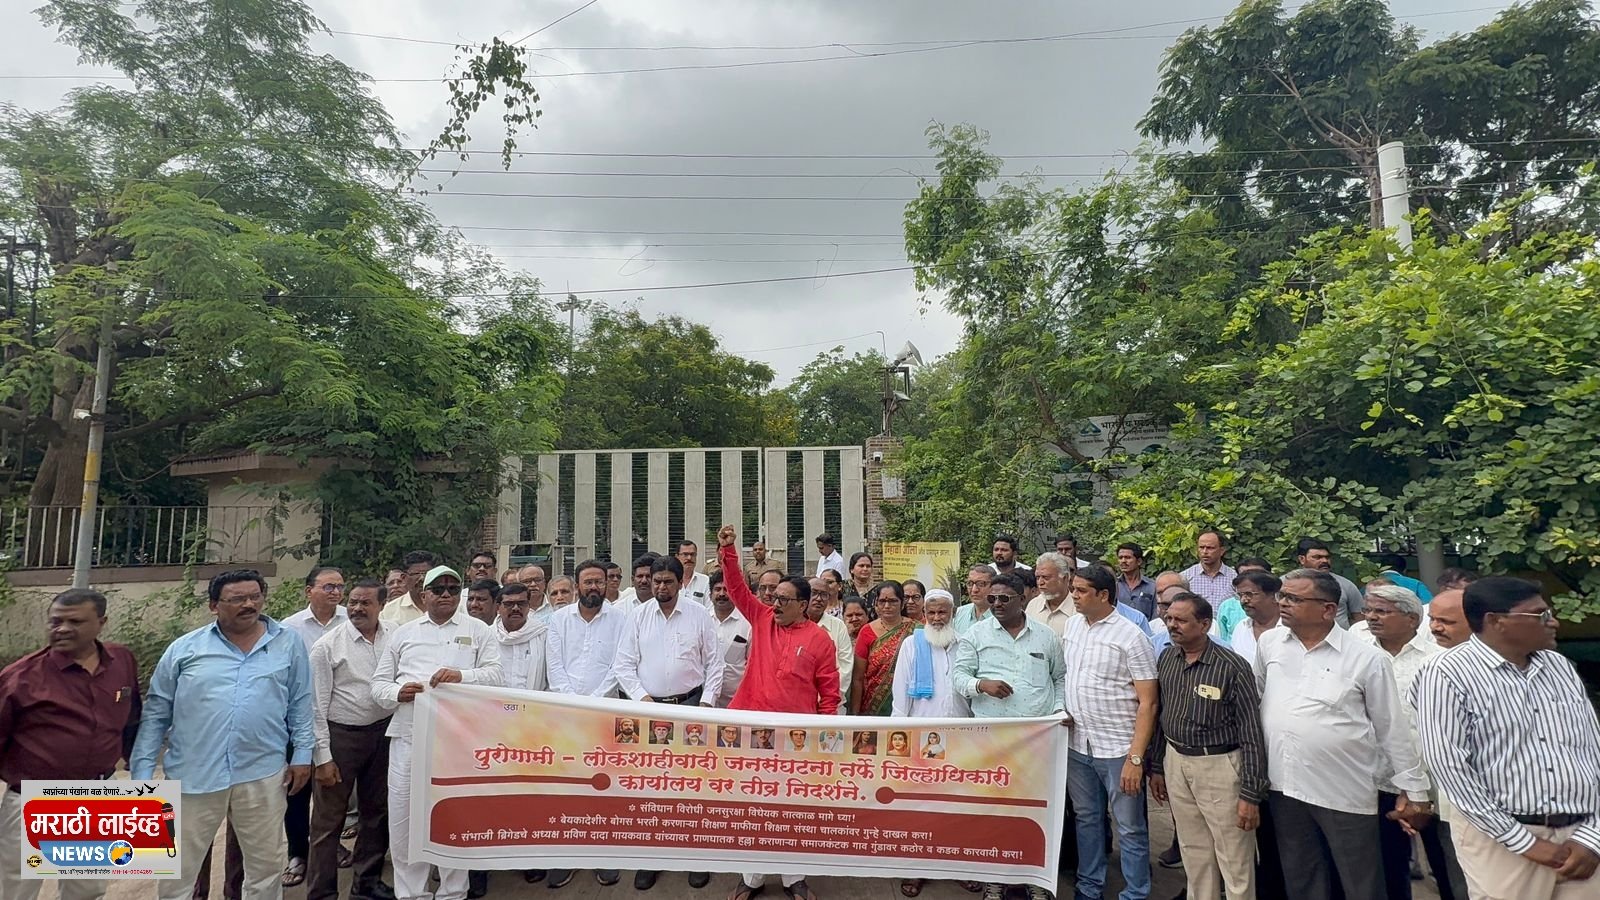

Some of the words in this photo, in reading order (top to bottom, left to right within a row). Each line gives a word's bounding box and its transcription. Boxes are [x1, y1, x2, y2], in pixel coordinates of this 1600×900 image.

[504, 704, 519, 712] उठा
[474, 743, 555, 770] पुरोगामी
[583, 747, 718, 770] लोकशाहीवादी
[724, 753, 832, 777] जनसंघटना
[840, 758, 875, 780] तर्फे
[882, 761, 1011, 786] जिल्हाधिकारी
[618, 771, 703, 792] कार्यालय
[708, 779, 735, 794] वर
[740, 776, 780, 797] तीव्र
[786, 779, 867, 801] निदर्शने.
[640, 802, 673, 814] संविधान
[677, 803, 703, 815] विरोधी
[707, 807, 745, 818] जनसुरक्षा
[748, 807, 779, 818] विधेयक
[782, 812, 815, 821] तात्काळ
[818, 810, 834, 821] मागे
[838, 813, 855, 823] घ्या!
[610, 814, 633, 826] बोगस
[637, 816, 658, 828] भरती
[701, 819, 727, 830] शिक्षण
[731, 820, 762, 832] माफीया
[764, 822, 790, 833] शिक्षण
[794, 823, 817, 834] संस्था
[820, 825, 860, 837] चालकांवर
[863, 827, 880, 840] गुन्हे
[883, 830, 908, 839] दाखल
[911, 831, 932, 841] करा!
[461, 828, 494, 841] संभाजी
[497, 828, 528, 840] ब्रिगेडचे
[531, 830, 559, 840] अध्यक्ष
[563, 828, 586, 840] प्रविण
[590, 831, 609, 840] दादा
[612, 831, 651, 841] गायकवाड
[655, 830, 689, 842] यांच्यावर
[693, 834, 735, 844] प्राणघातक
[738, 836, 755, 846] हल्ला
[800, 838, 849, 850] समाजकंटक
[852, 842, 867, 851] गाव
[871, 841, 897, 854] गुंडावर
[900, 842, 924, 853] कठोर
[937, 847, 960, 855] कडक
[963, 847, 998, 858] कारवायी
[1002, 850, 1023, 860] करा!
